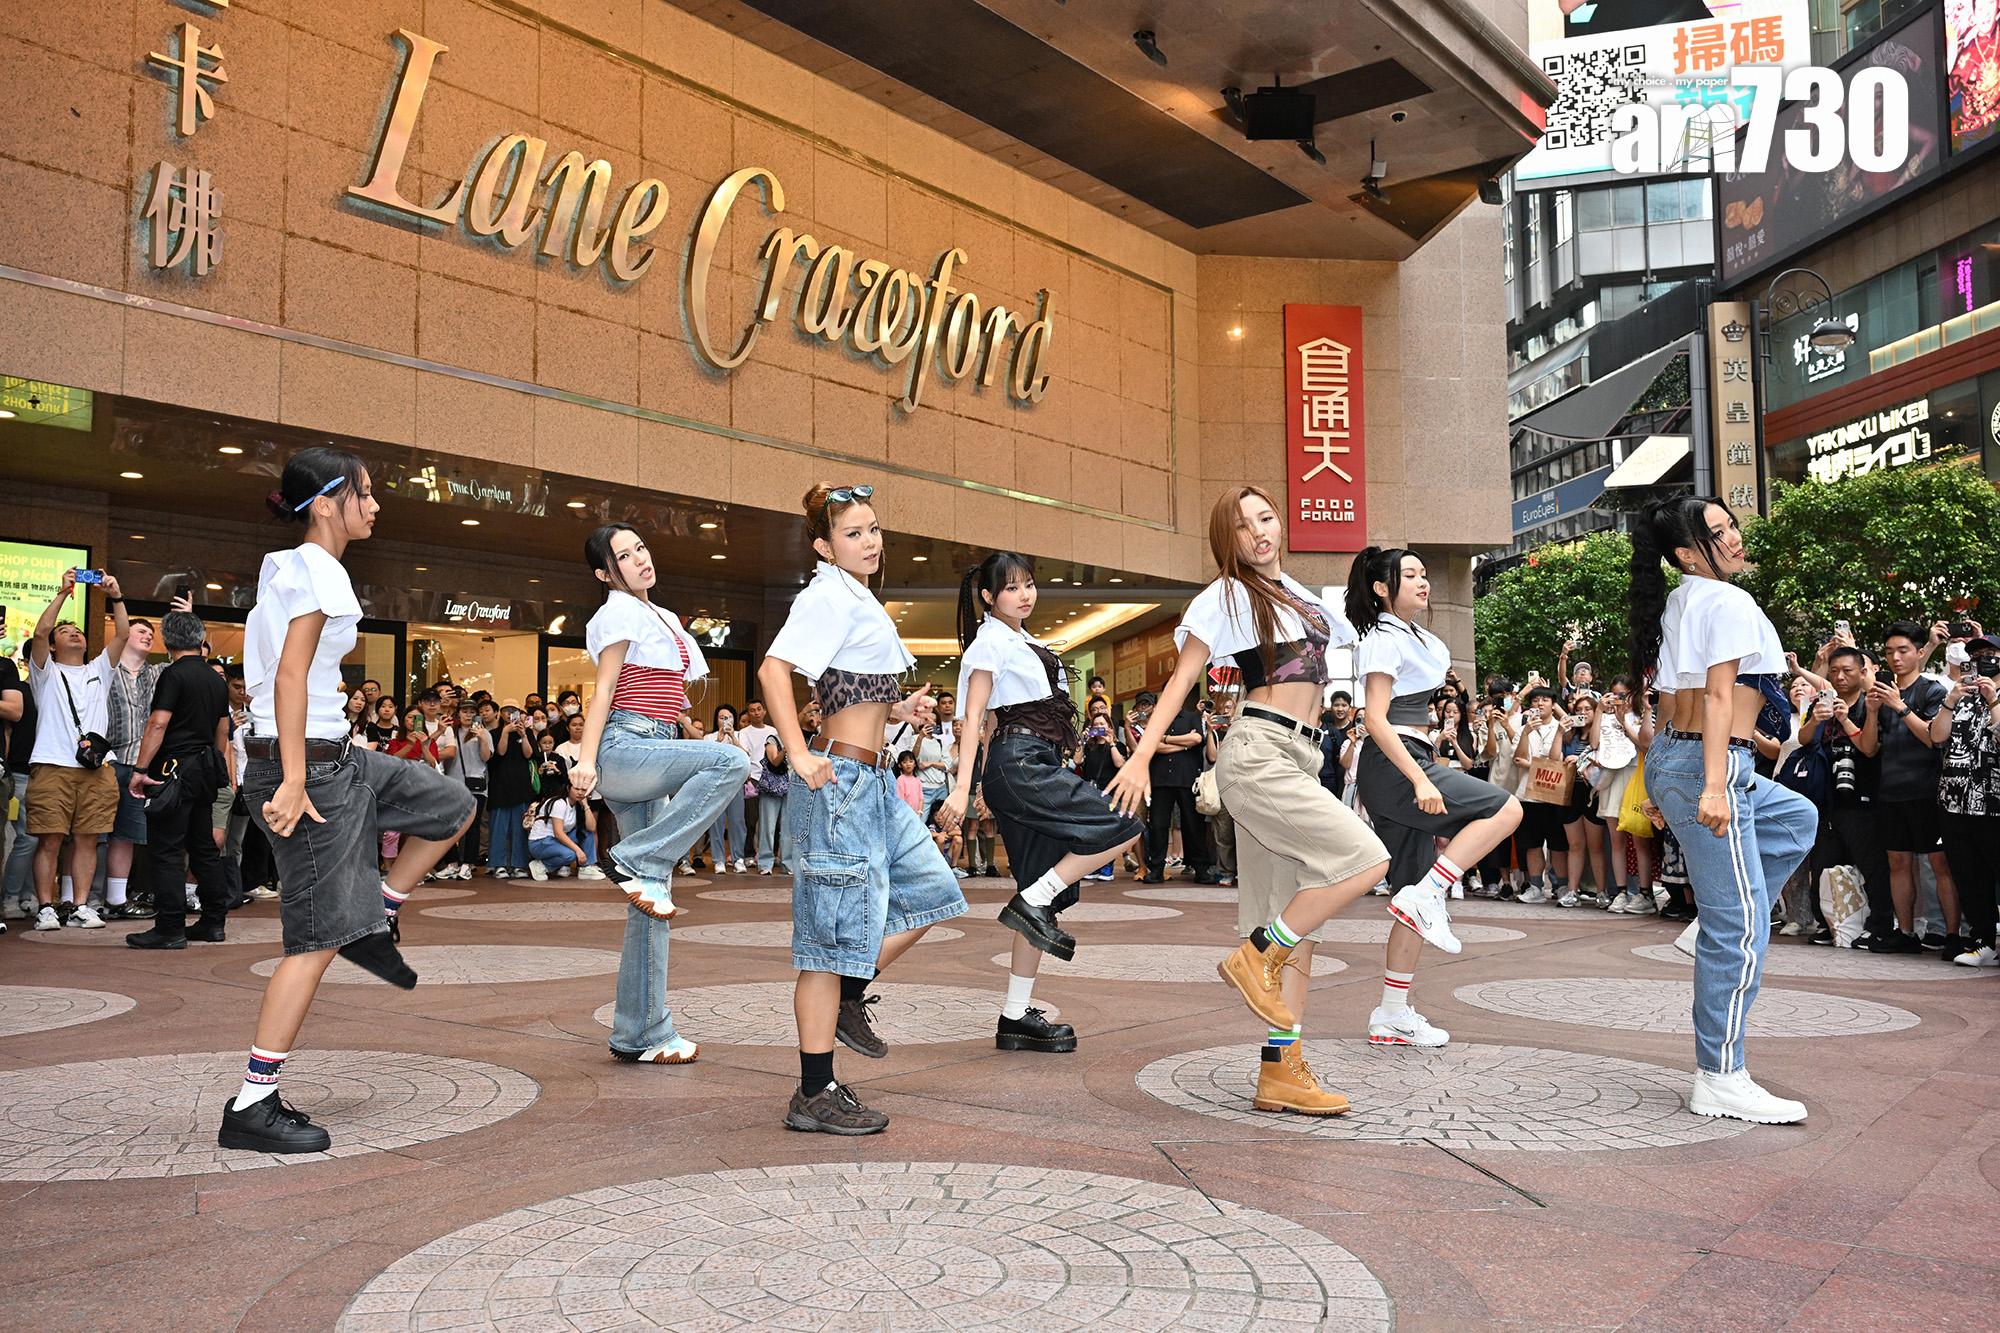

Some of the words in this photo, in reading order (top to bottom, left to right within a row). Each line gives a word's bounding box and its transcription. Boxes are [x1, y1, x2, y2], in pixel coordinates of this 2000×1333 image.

[1673, 15, 1784, 75] 掃碼
[141, 0, 229, 277] 卡佛
[348, 28, 670, 283] Lane
[687, 166, 1055, 413] Crawford
[1297, 337, 1353, 483] 食通天
[1723, 358, 1754, 508] 英皇鐘錶
[1301, 498, 1354, 509] FOOD
[1522, 502, 1556, 524] EuroEyes
[1301, 511, 1355, 521] FORUM
[0, 554, 29, 566] SHOP
[31, 557, 56, 568] OUR
[444, 600, 468, 616] Lane
[468, 601, 511, 623] Crawford
[1535, 767, 1563, 784] MUJI
